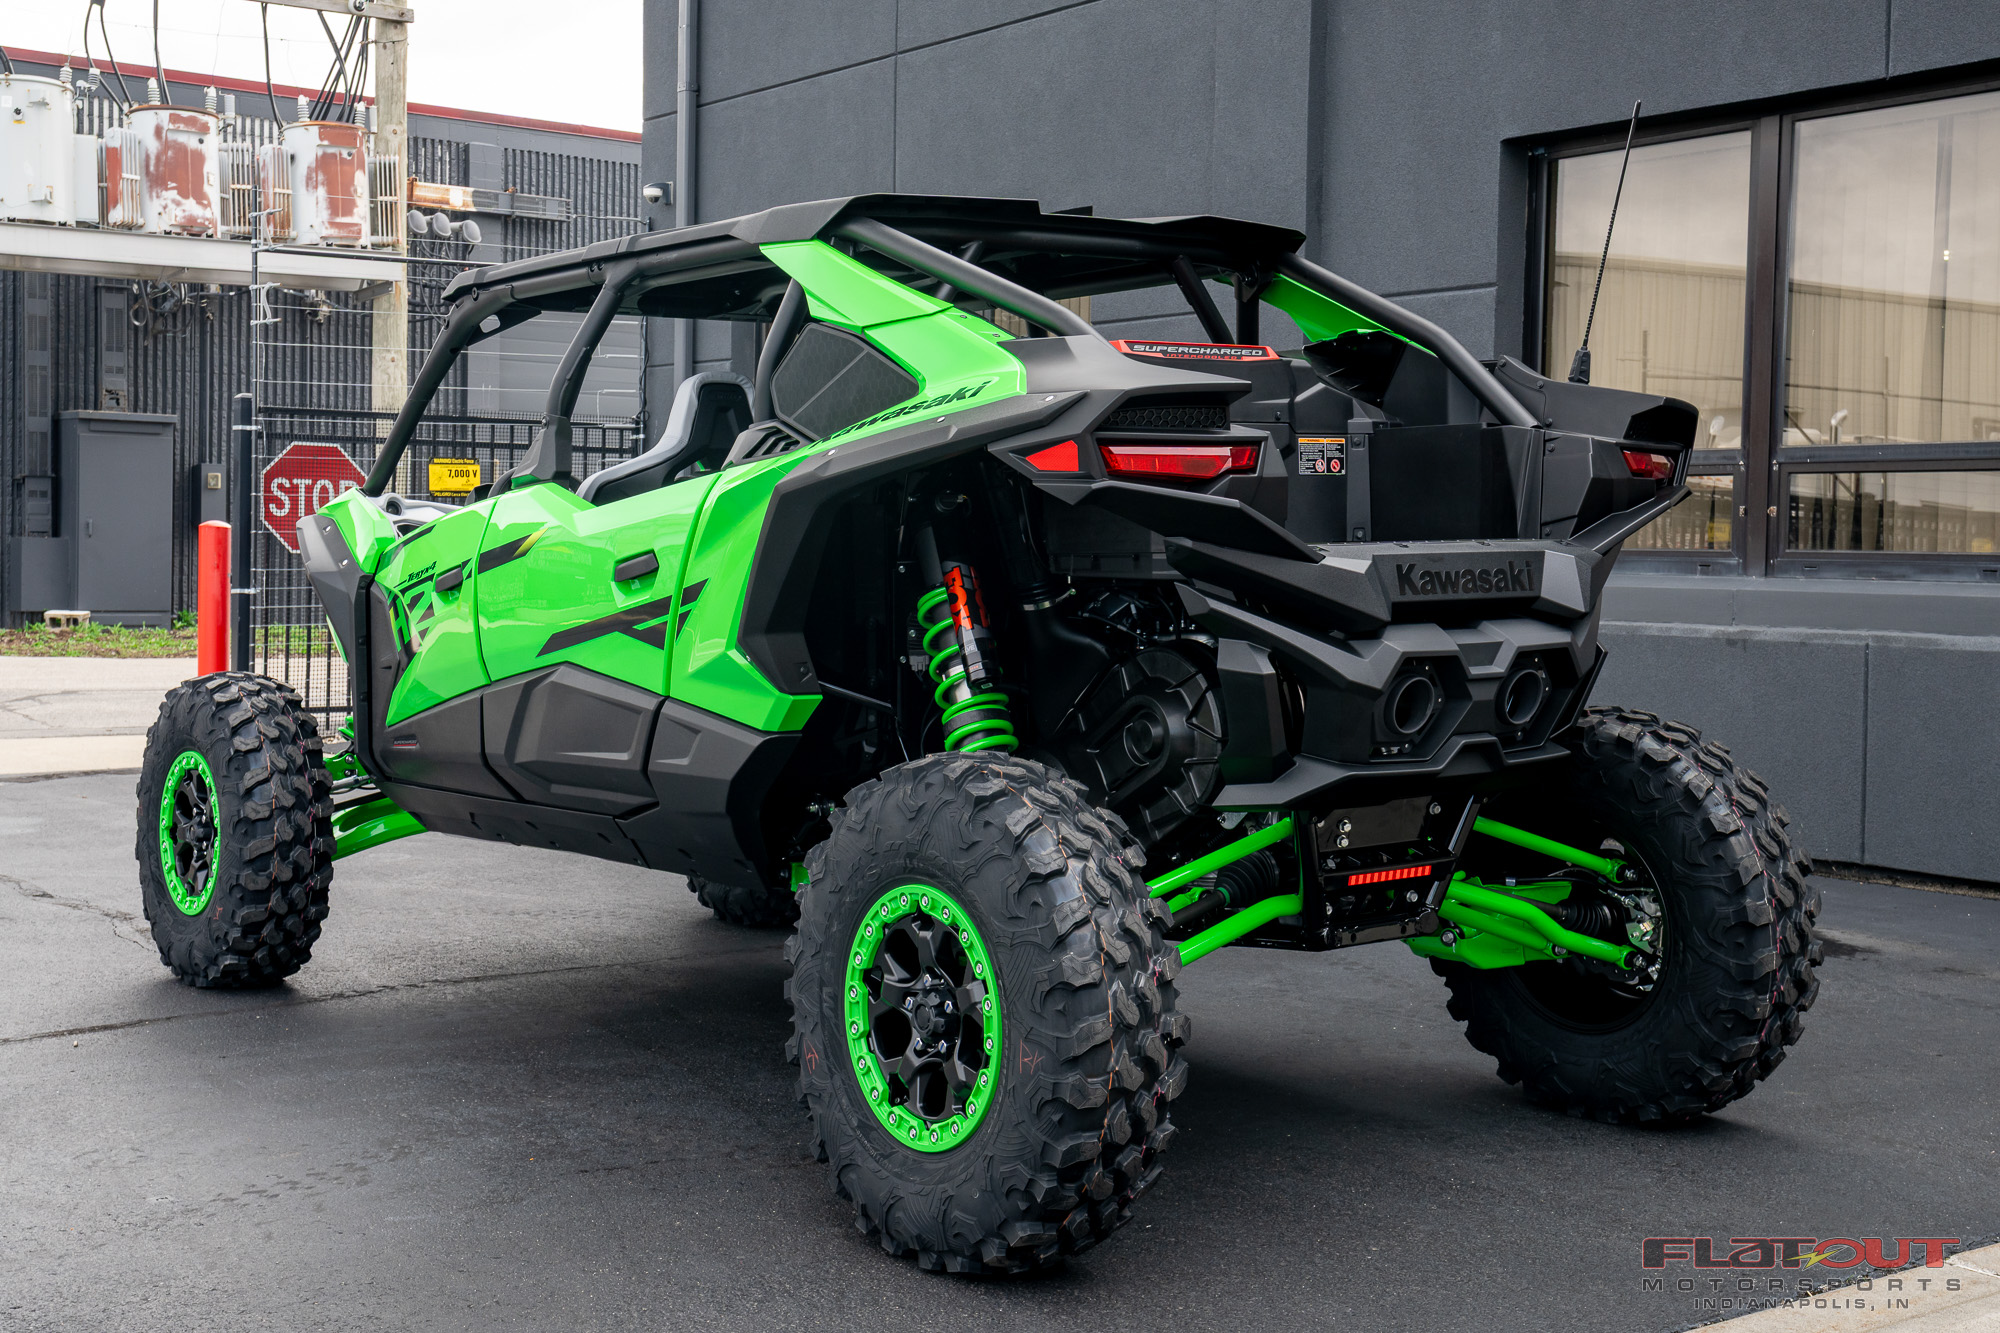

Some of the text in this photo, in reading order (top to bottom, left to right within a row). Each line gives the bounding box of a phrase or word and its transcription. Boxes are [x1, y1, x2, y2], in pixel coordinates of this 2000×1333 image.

[1132, 344, 1262, 356] SUPERCHARGED
[447, 469, 478, 479] 7,000 V
[1396, 561, 1535, 595] Kawasaki
[942, 566, 973, 637] FOX
